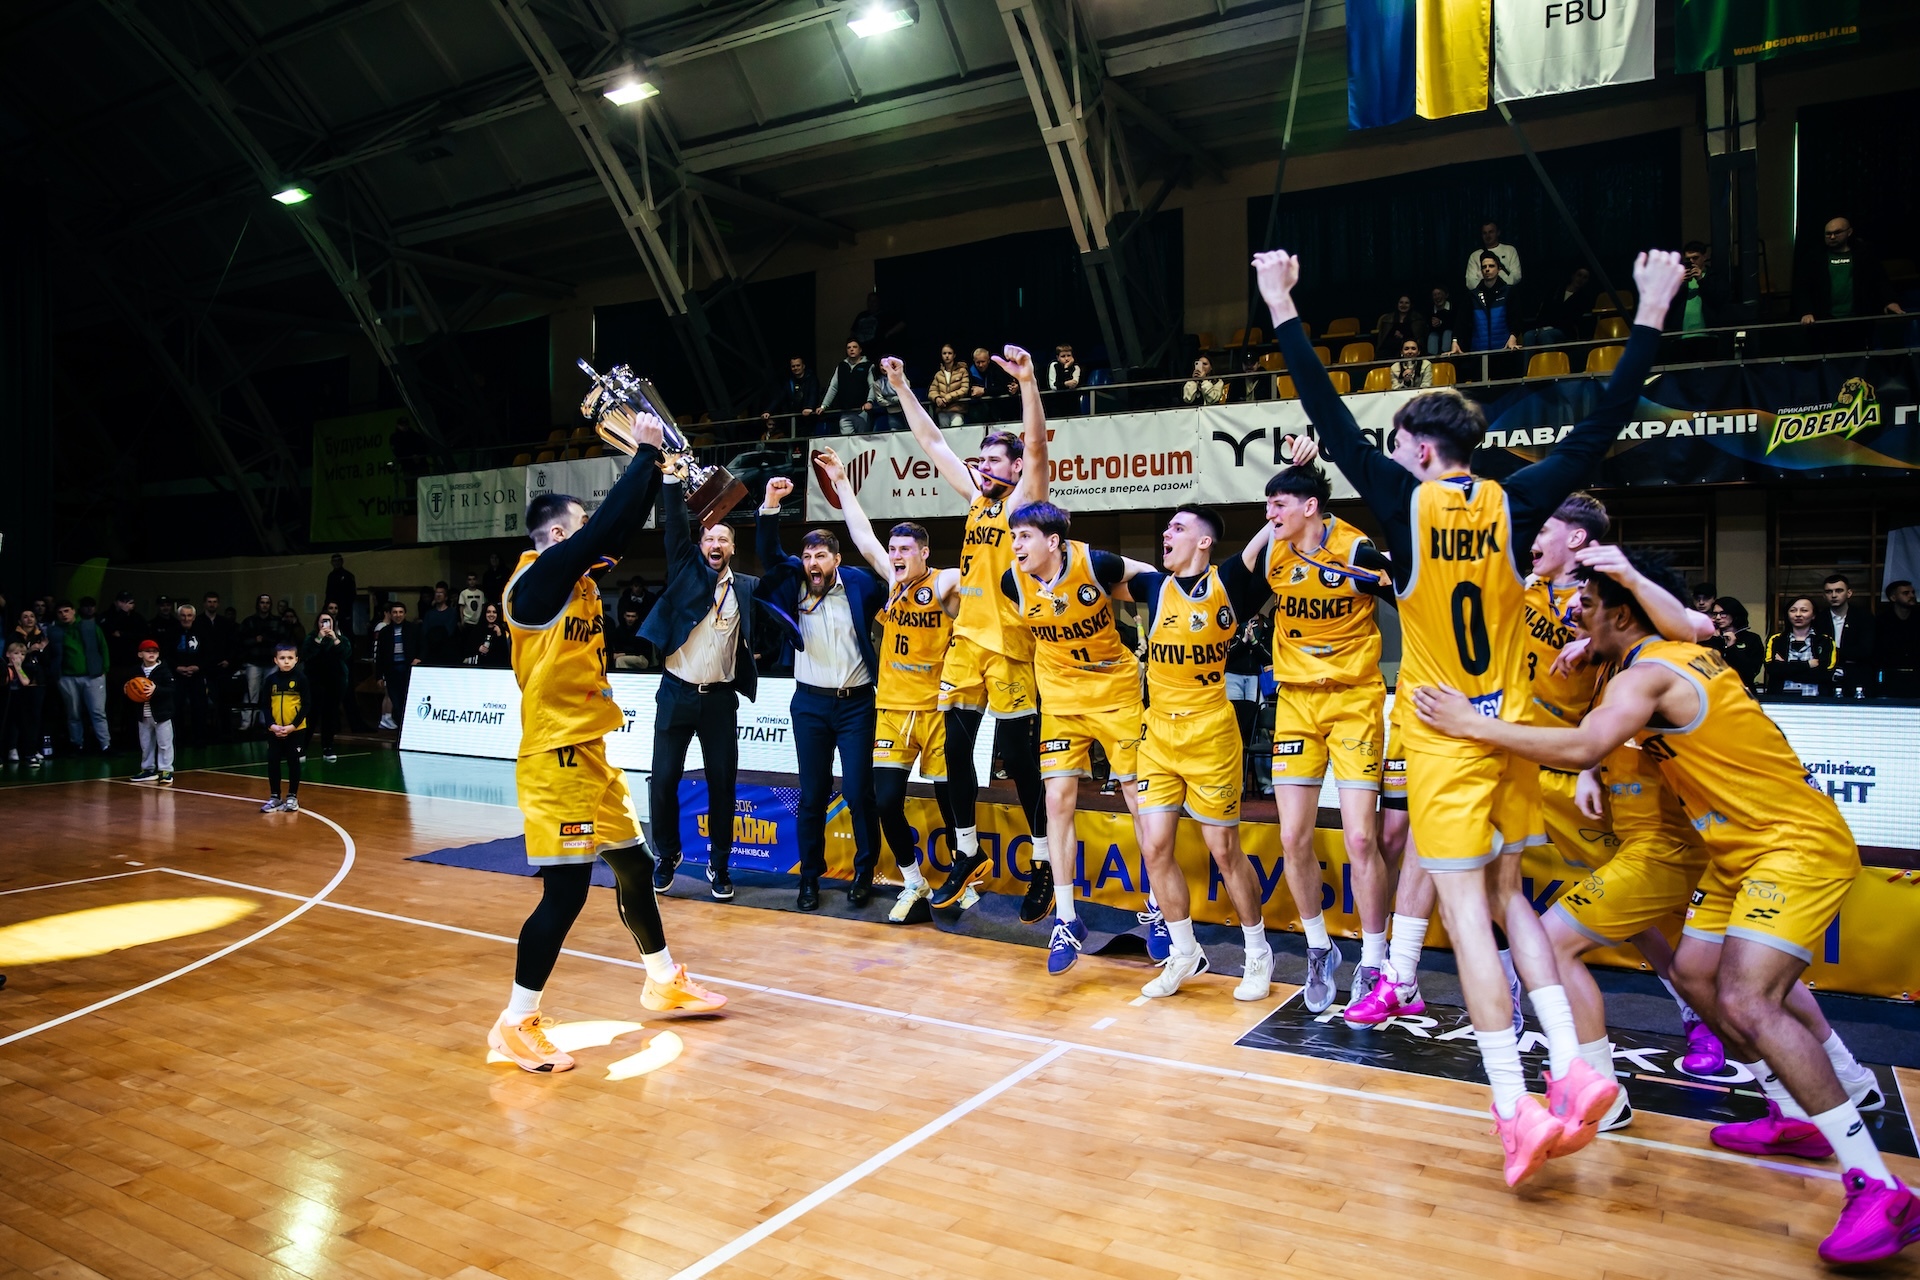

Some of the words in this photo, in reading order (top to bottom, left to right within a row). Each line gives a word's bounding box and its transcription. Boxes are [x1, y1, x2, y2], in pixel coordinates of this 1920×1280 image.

[1545, 0, 1607, 28] FBU
[1777, 402, 1833, 415] ПРИКАРПАТТЯ
[1482, 424, 1575, 450] ЛАВА
[1617, 411, 1758, 441] КРАЇНІ!
[1766, 390, 1880, 455] ГОВЕРЛА
[324, 434, 383, 457] Будуємо
[324, 464, 363, 481] міста,
[367, 462, 375, 477] а
[450, 489, 517, 508] FRISOR
[892, 487, 940, 498] MALL
[1048, 487, 1108, 499] Рухаймося
[1110, 485, 1151, 497] вперед
[1153, 480, 1193, 492] разом!
[1451, 580, 1491, 677] 0
[894, 633, 909, 656] 16
[1070, 646, 1091, 663] 11
[482, 701, 507, 710] клініка
[432, 708, 505, 726] МЕД-АТЛАНТ
[756, 714, 790, 726] клініка
[556, 746, 578, 768] 12
[1802, 760, 1876, 777] клініка
